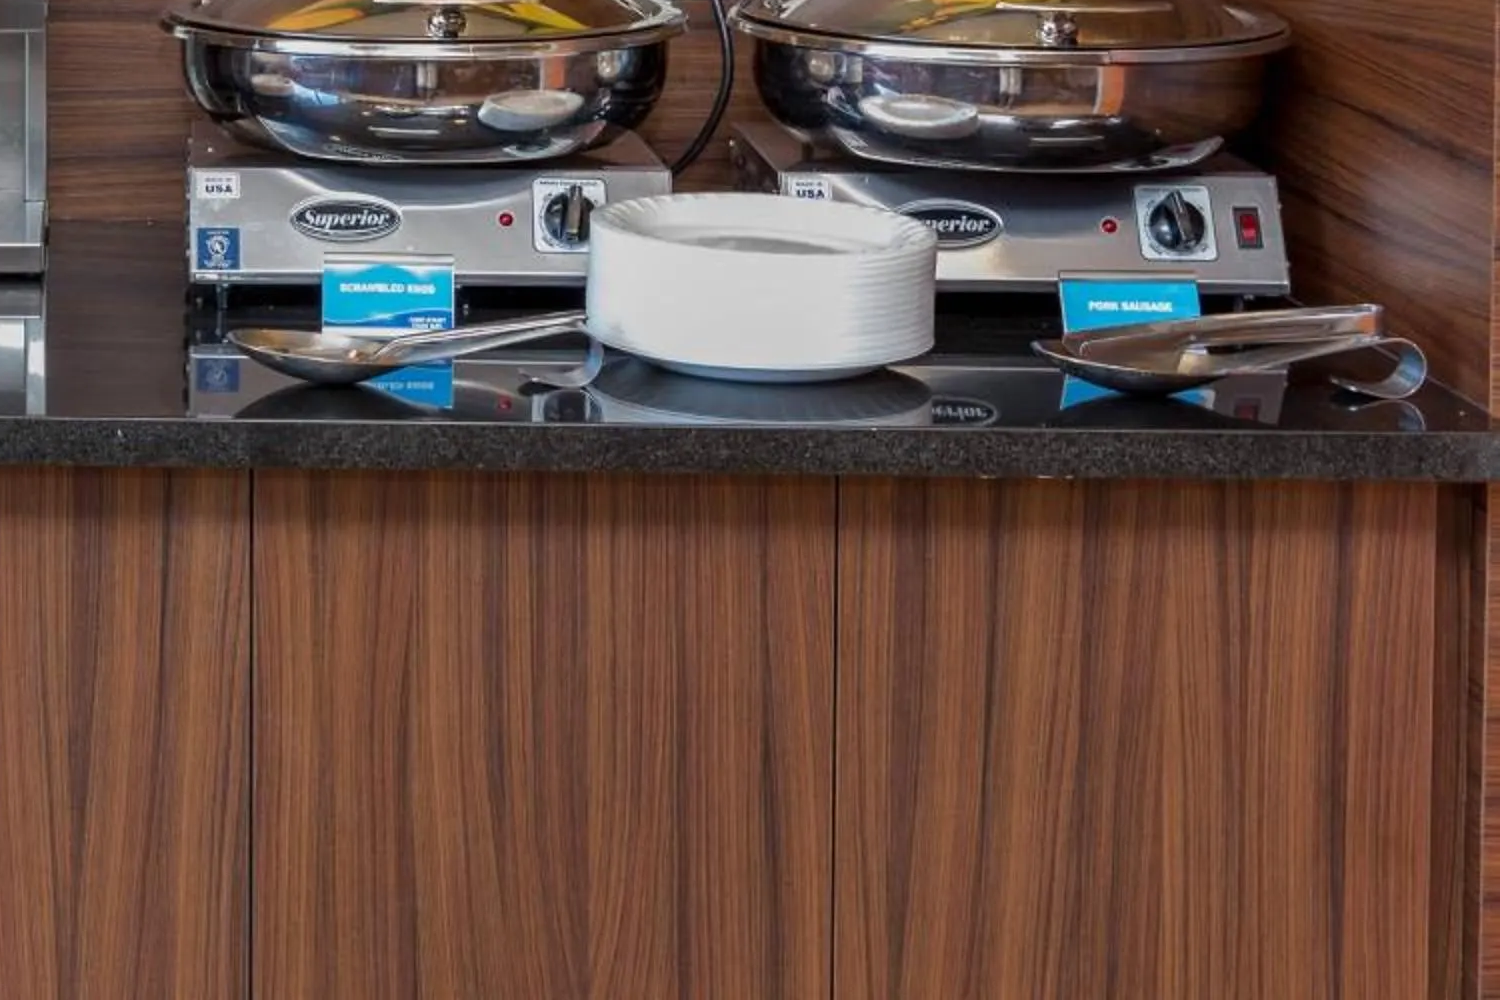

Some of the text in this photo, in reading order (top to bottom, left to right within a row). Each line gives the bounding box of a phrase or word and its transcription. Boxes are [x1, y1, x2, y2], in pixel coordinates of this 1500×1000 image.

[205, 184, 233, 195] USA
[796, 189, 825, 199] USA
[303, 209, 390, 231] Superior
[339, 282, 437, 295] SCRAMBLED EGGS
[1088, 300, 1174, 313] PORK SAUSAGE
